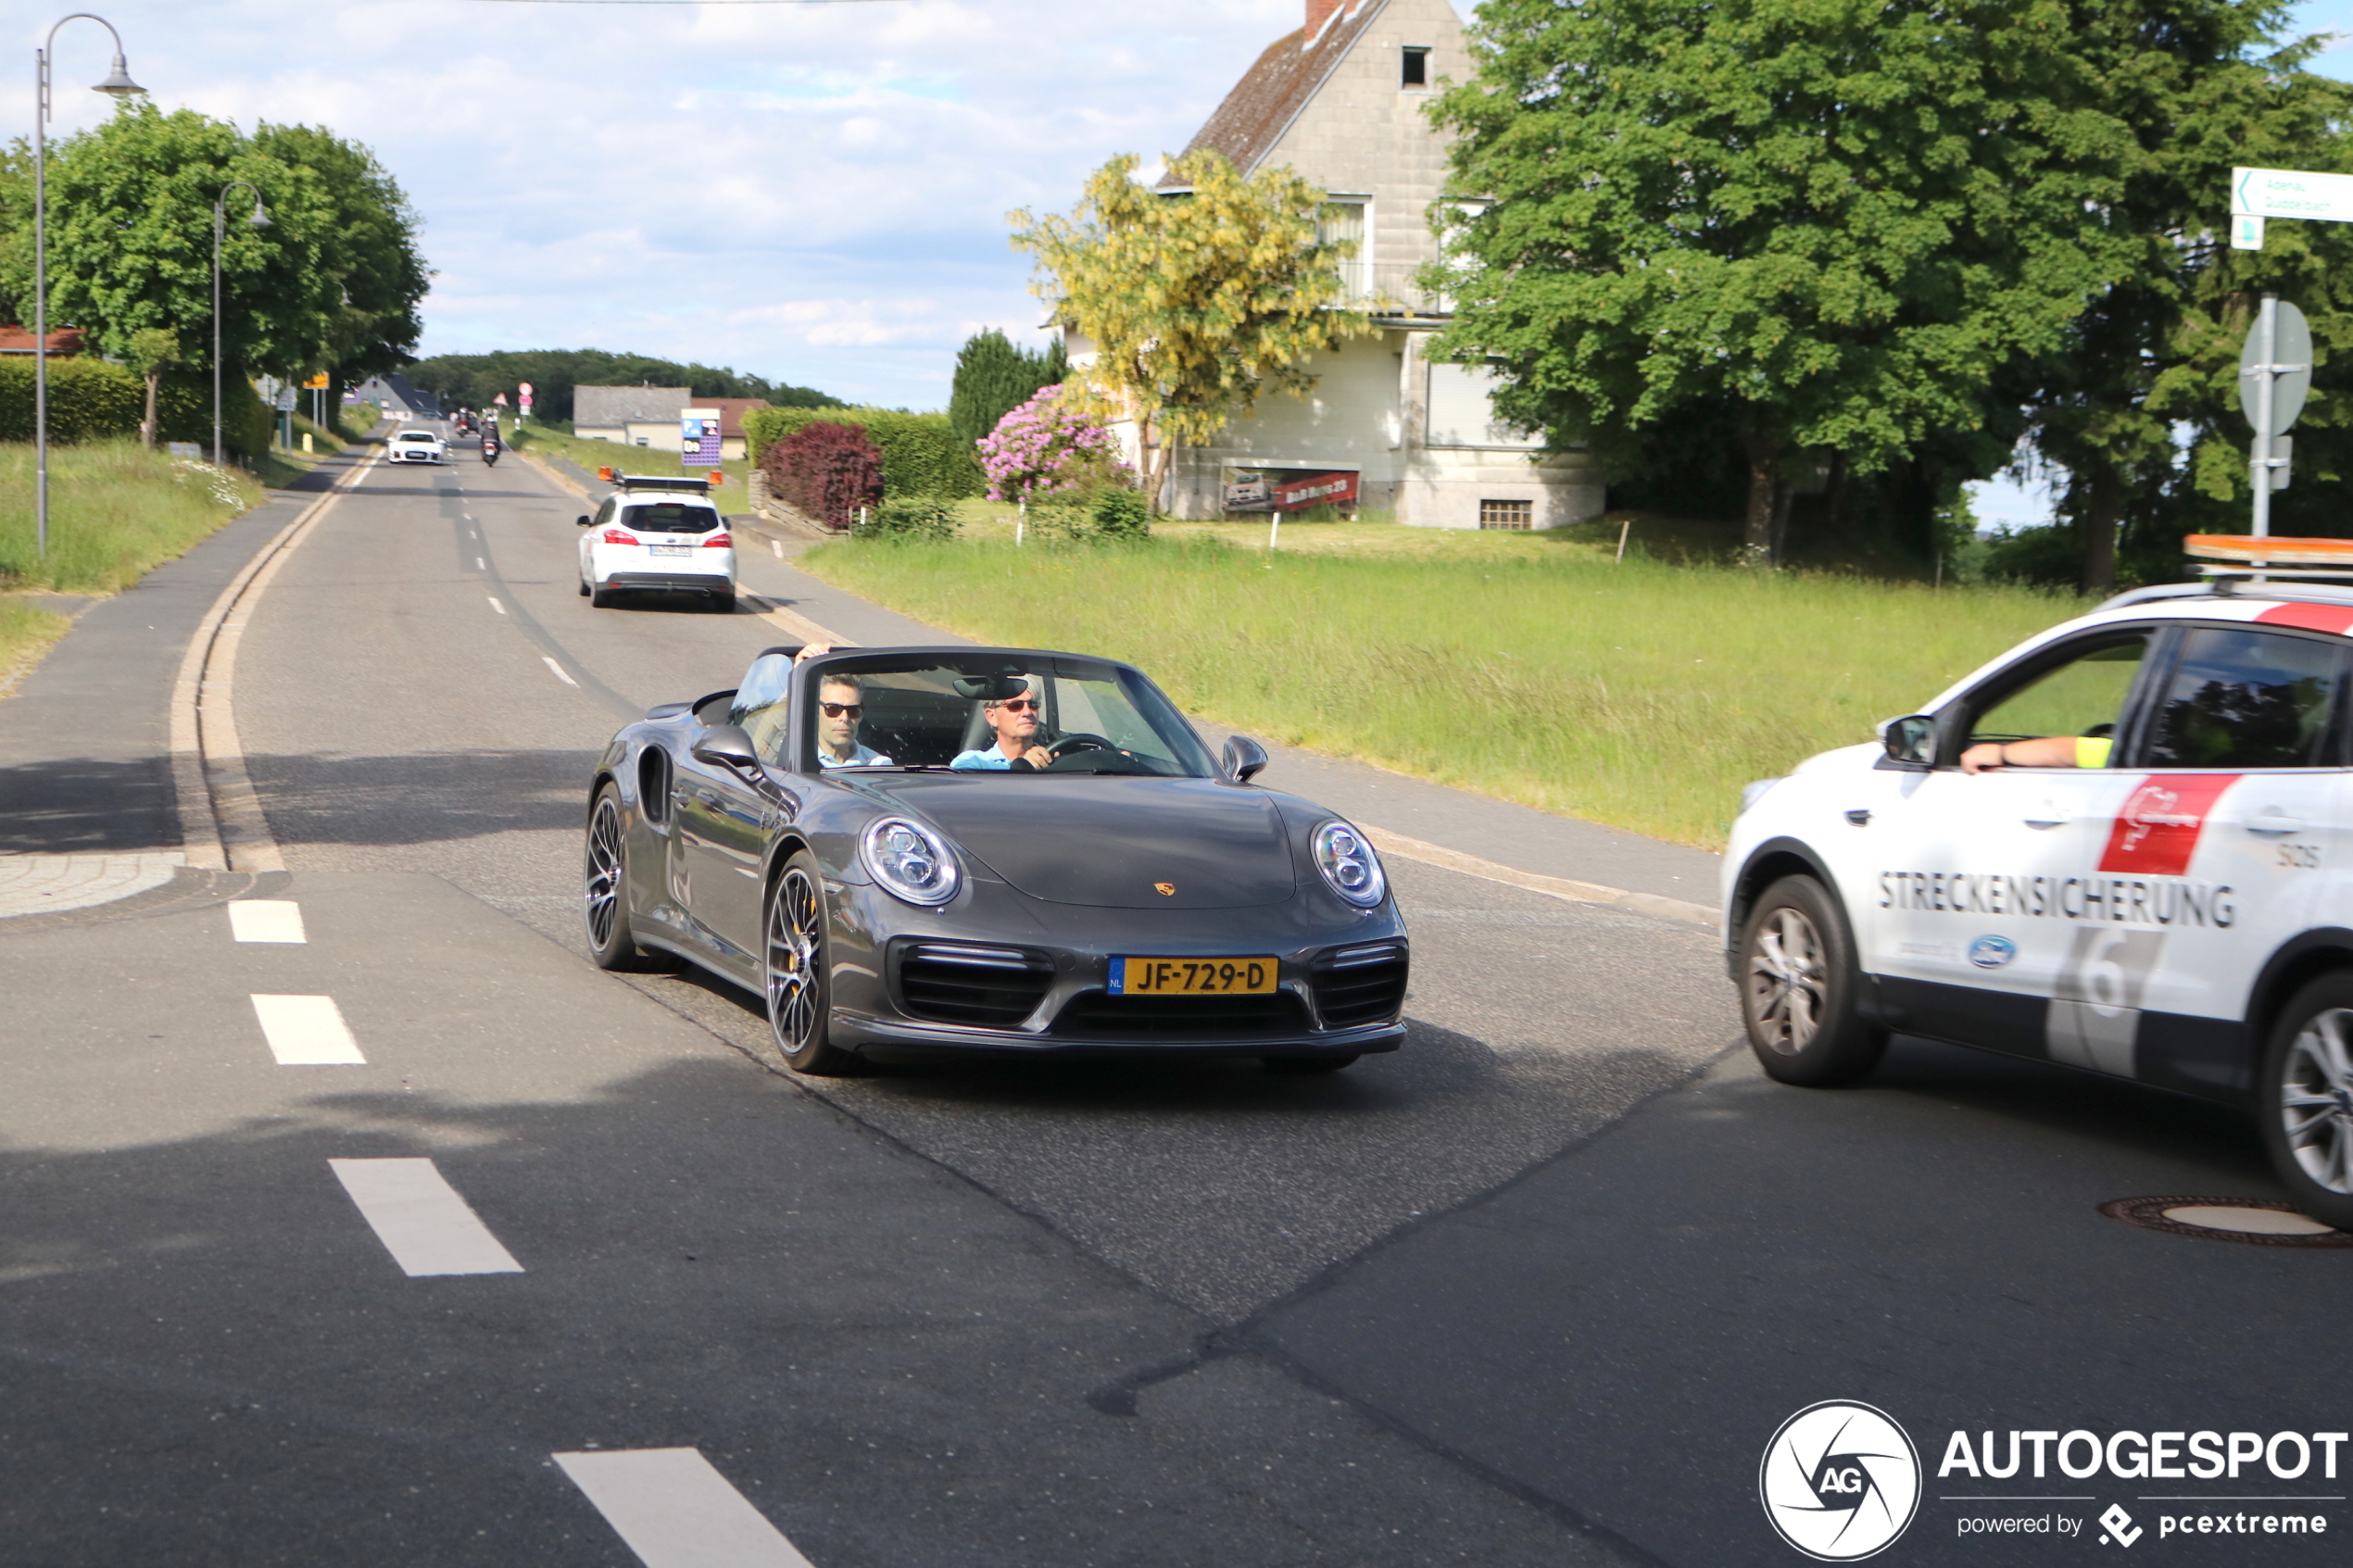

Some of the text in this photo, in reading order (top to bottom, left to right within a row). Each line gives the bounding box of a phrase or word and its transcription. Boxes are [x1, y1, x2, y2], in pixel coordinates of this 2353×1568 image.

[2277, 843, 2322, 869] SOS
[1878, 870, 2236, 928] STRECKENSICHERUNG
[1110, 979, 1122, 988] NL
[1138, 963, 1265, 990] JF-729-D
[2079, 927, 2129, 1018] 6
